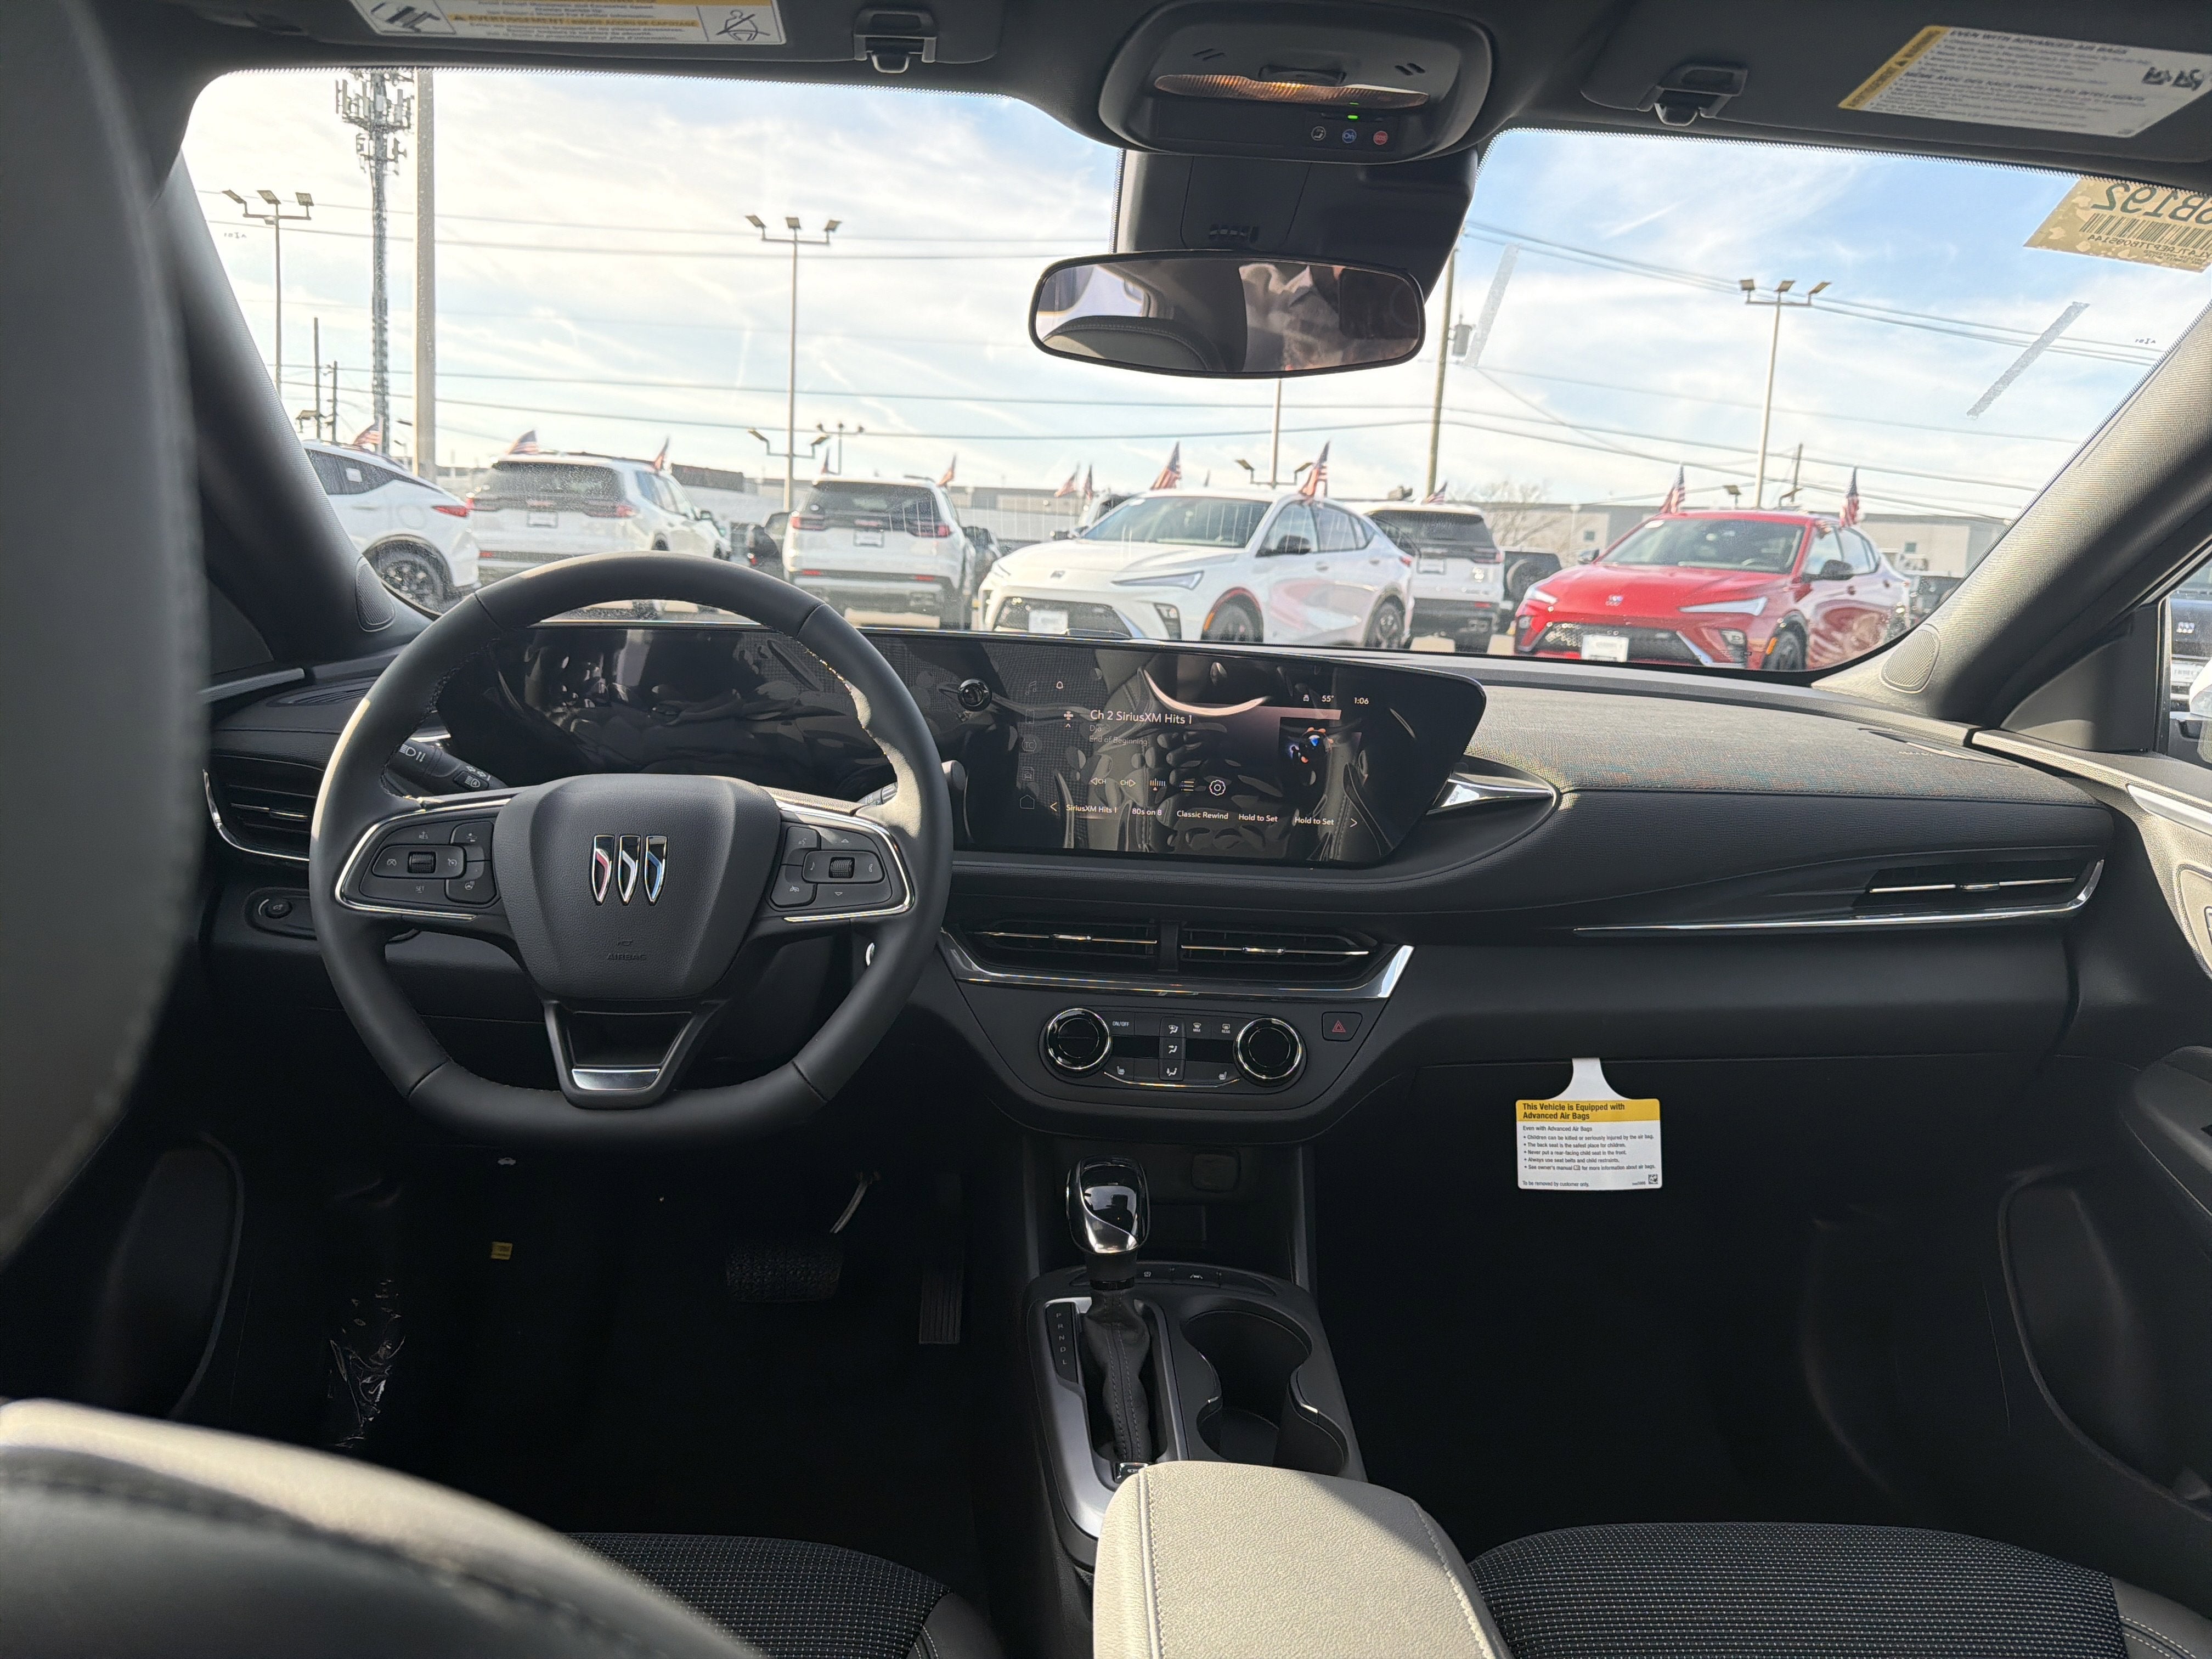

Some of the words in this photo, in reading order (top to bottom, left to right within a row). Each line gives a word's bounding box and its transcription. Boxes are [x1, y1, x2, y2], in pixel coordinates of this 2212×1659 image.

[1090, 709, 1104, 720] Ch
[1107, 710, 1113, 720] 2
[1116, 711, 1161, 723] SiriusXM
[1165, 714, 1186, 724] Hits
[1090, 724, 1102, 733] Djo
[1113, 737, 1148, 747] Beginning
[1066, 804, 1097, 812] SiriusXM
[1099, 805, 1113, 814] Hits
[1176, 810, 1201, 818] Classic
[1203, 811, 1229, 820] Rewind
[1576, 1103, 1608, 1112] Equipped
